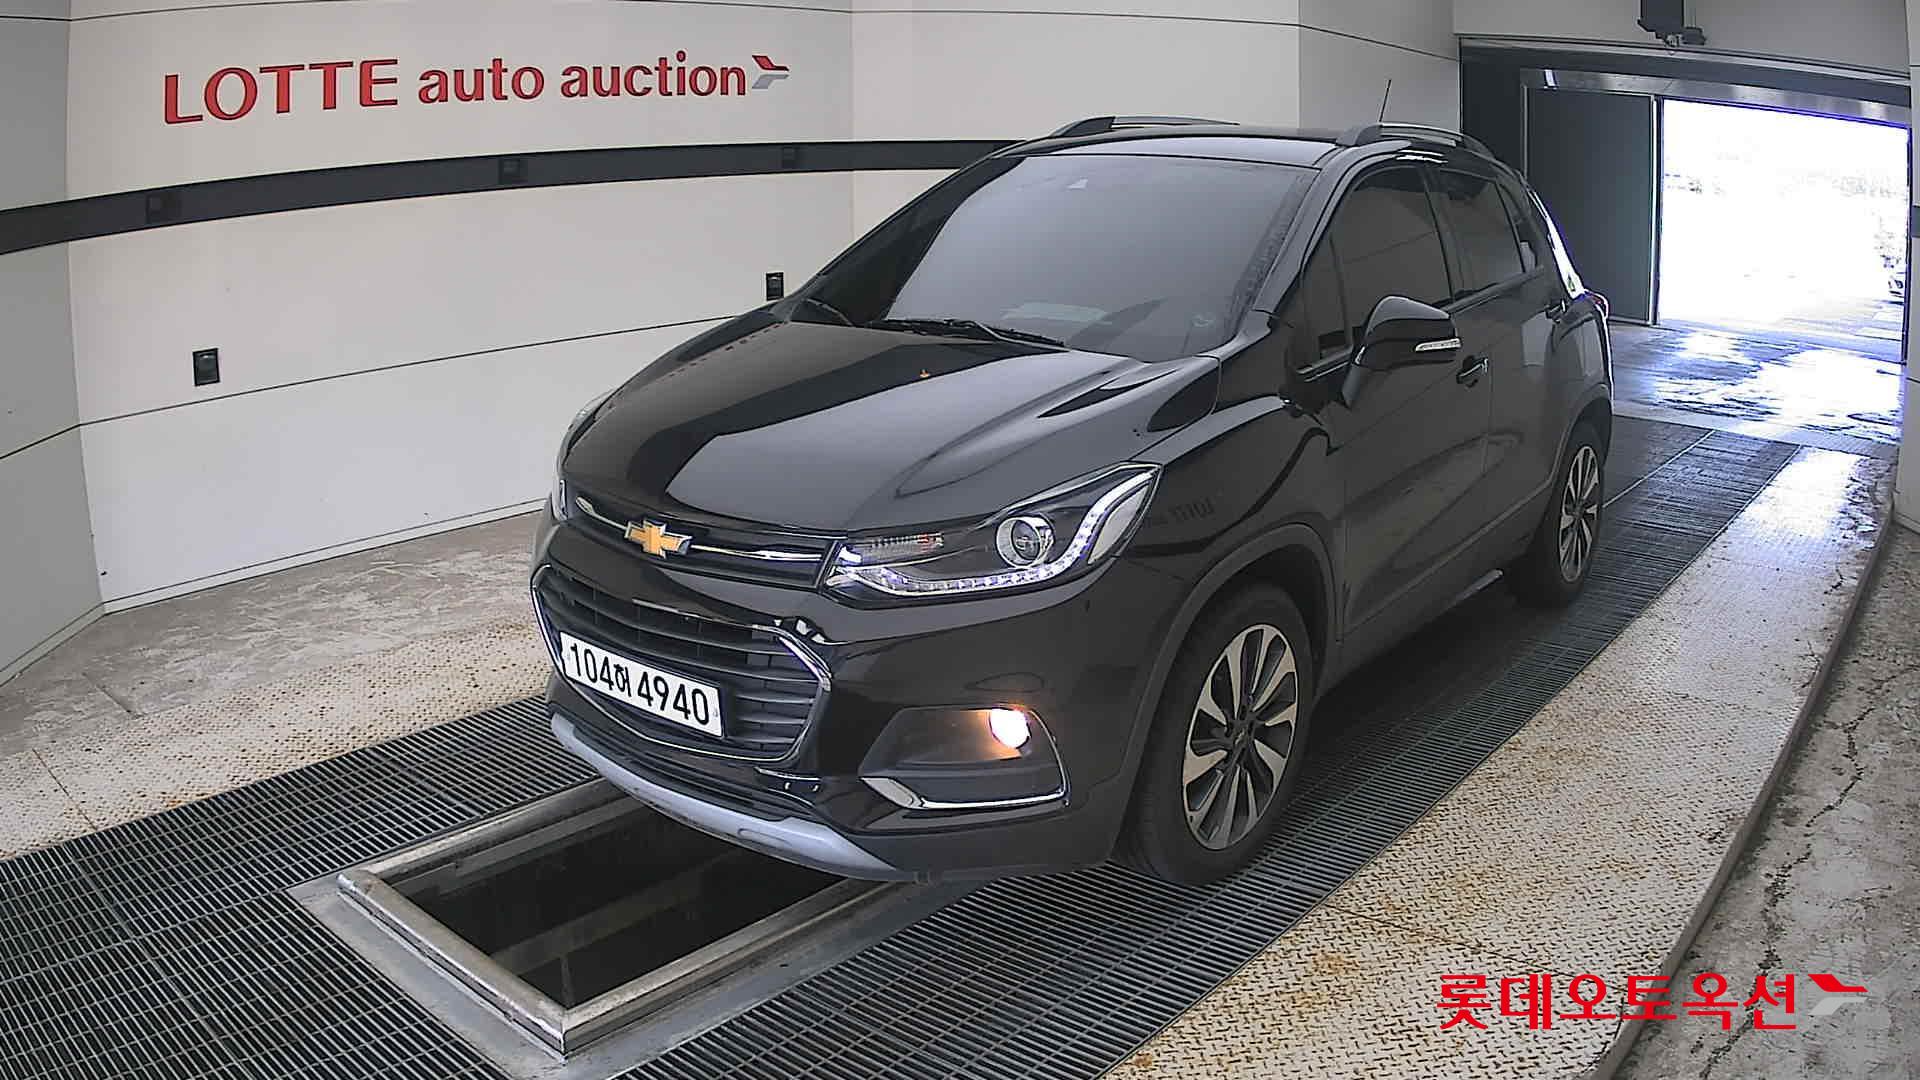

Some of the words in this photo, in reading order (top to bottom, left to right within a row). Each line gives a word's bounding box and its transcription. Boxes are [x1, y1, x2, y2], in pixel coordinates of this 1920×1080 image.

[163, 59, 398, 124] LOTTE
[418, 57, 545, 103] auto
[561, 51, 747, 97] auction
[570, 643, 632, 697] 104허
[637, 671, 710, 725] 4940
